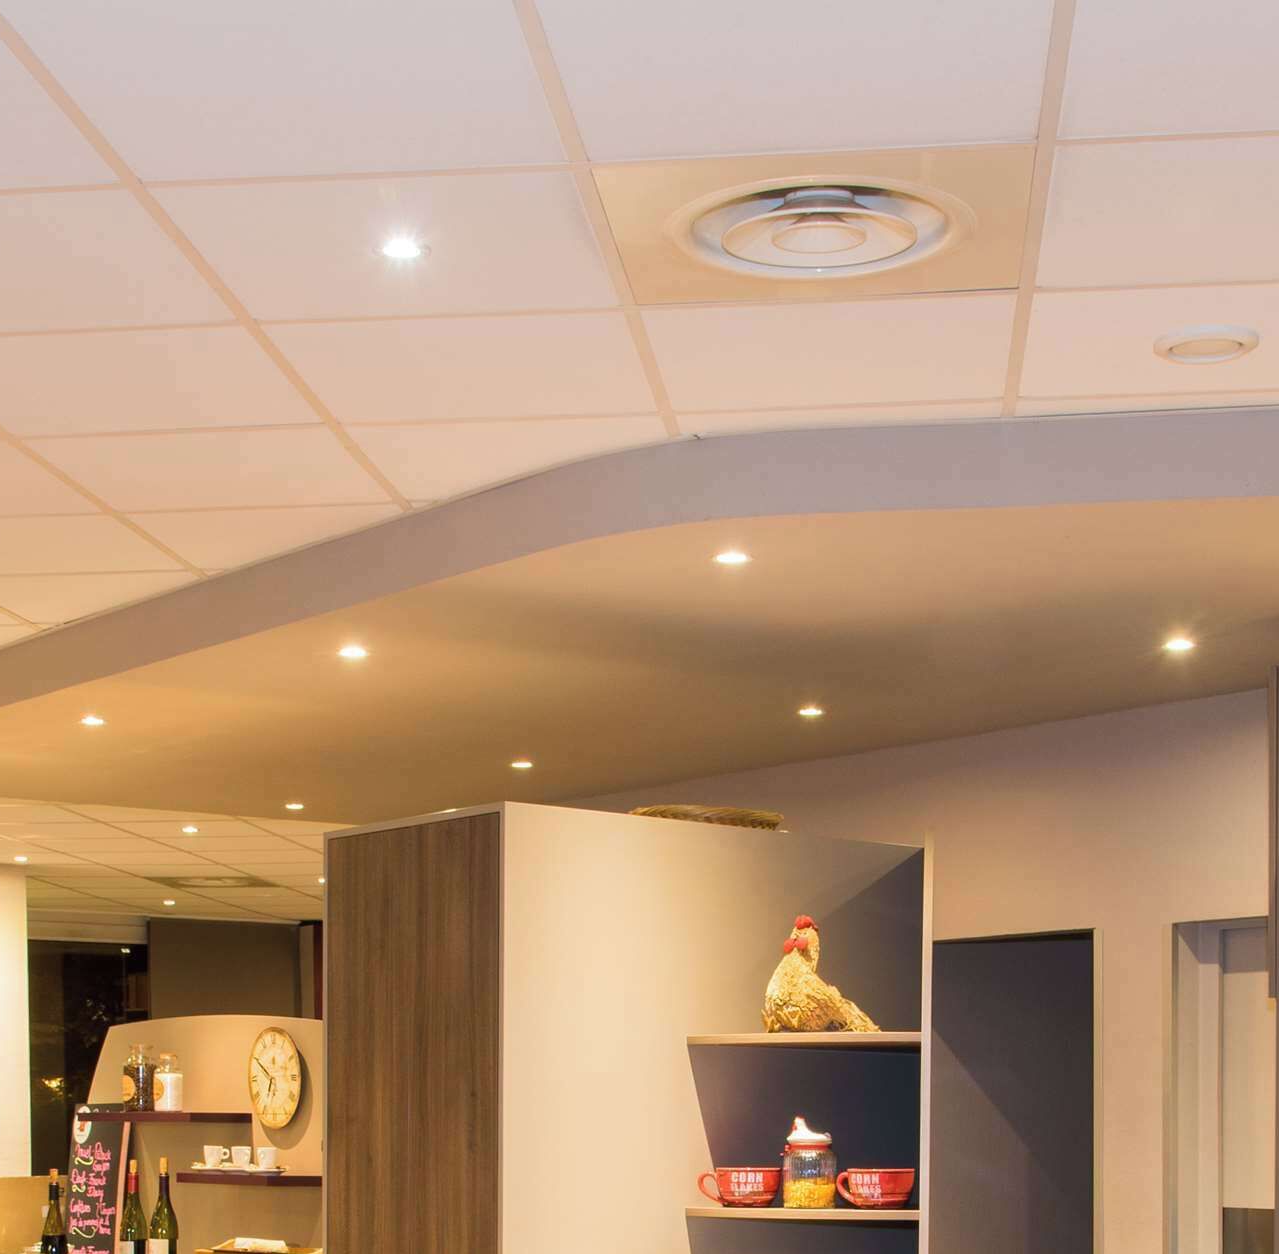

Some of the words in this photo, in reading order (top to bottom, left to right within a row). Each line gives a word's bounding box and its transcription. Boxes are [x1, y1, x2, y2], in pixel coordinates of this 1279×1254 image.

[731, 1171, 764, 1183] CORN
[851, 1173, 880, 1184] CORN
[730, 1182, 764, 1192] FLAKES
